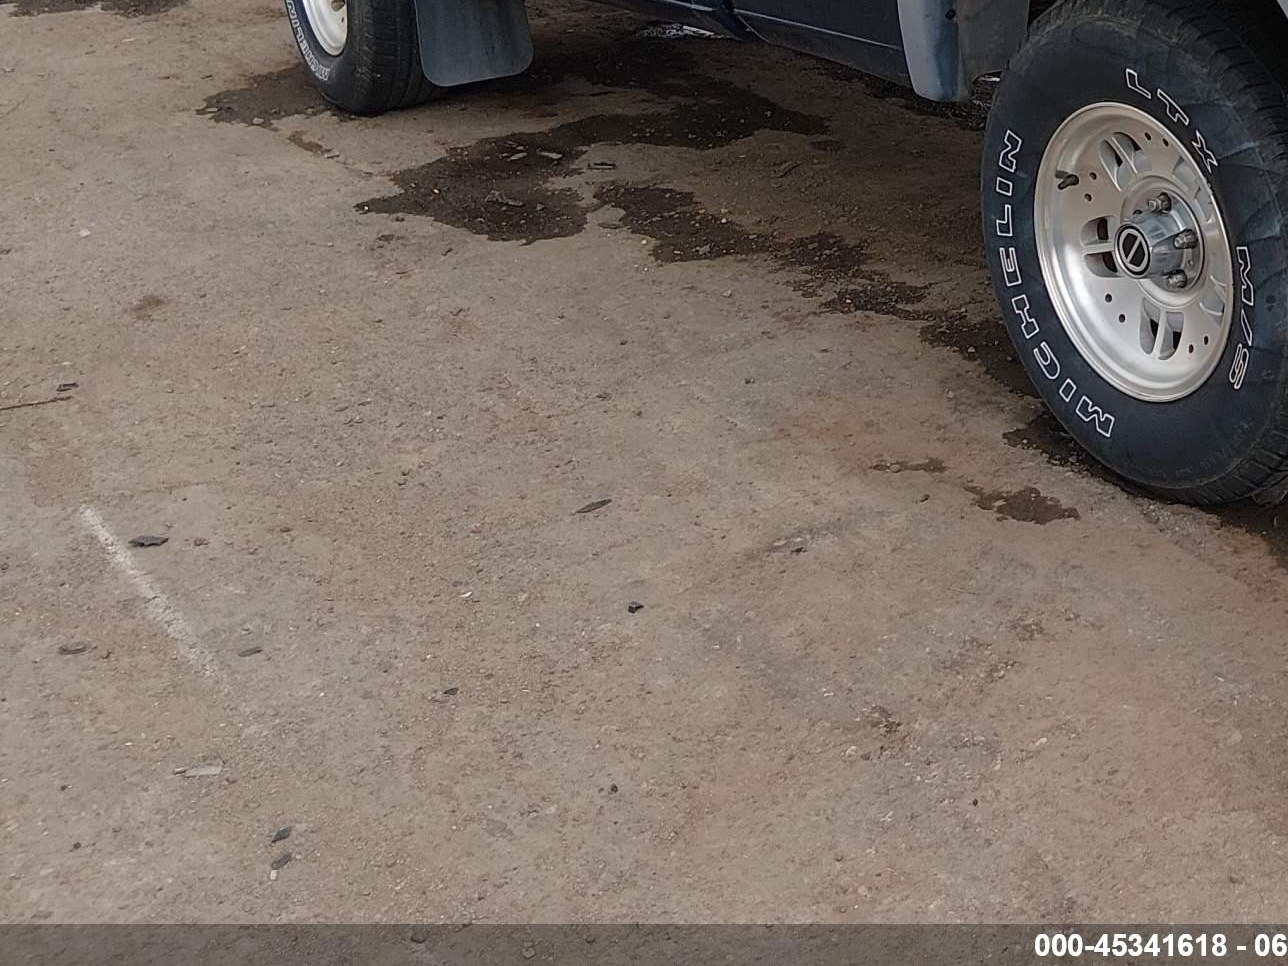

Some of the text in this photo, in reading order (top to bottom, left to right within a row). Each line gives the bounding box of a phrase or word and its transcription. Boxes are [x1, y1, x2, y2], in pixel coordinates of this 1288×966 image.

[995, 130, 1116, 438] MICHELIN
[1125, 67, 1256, 390] LTX M/S
